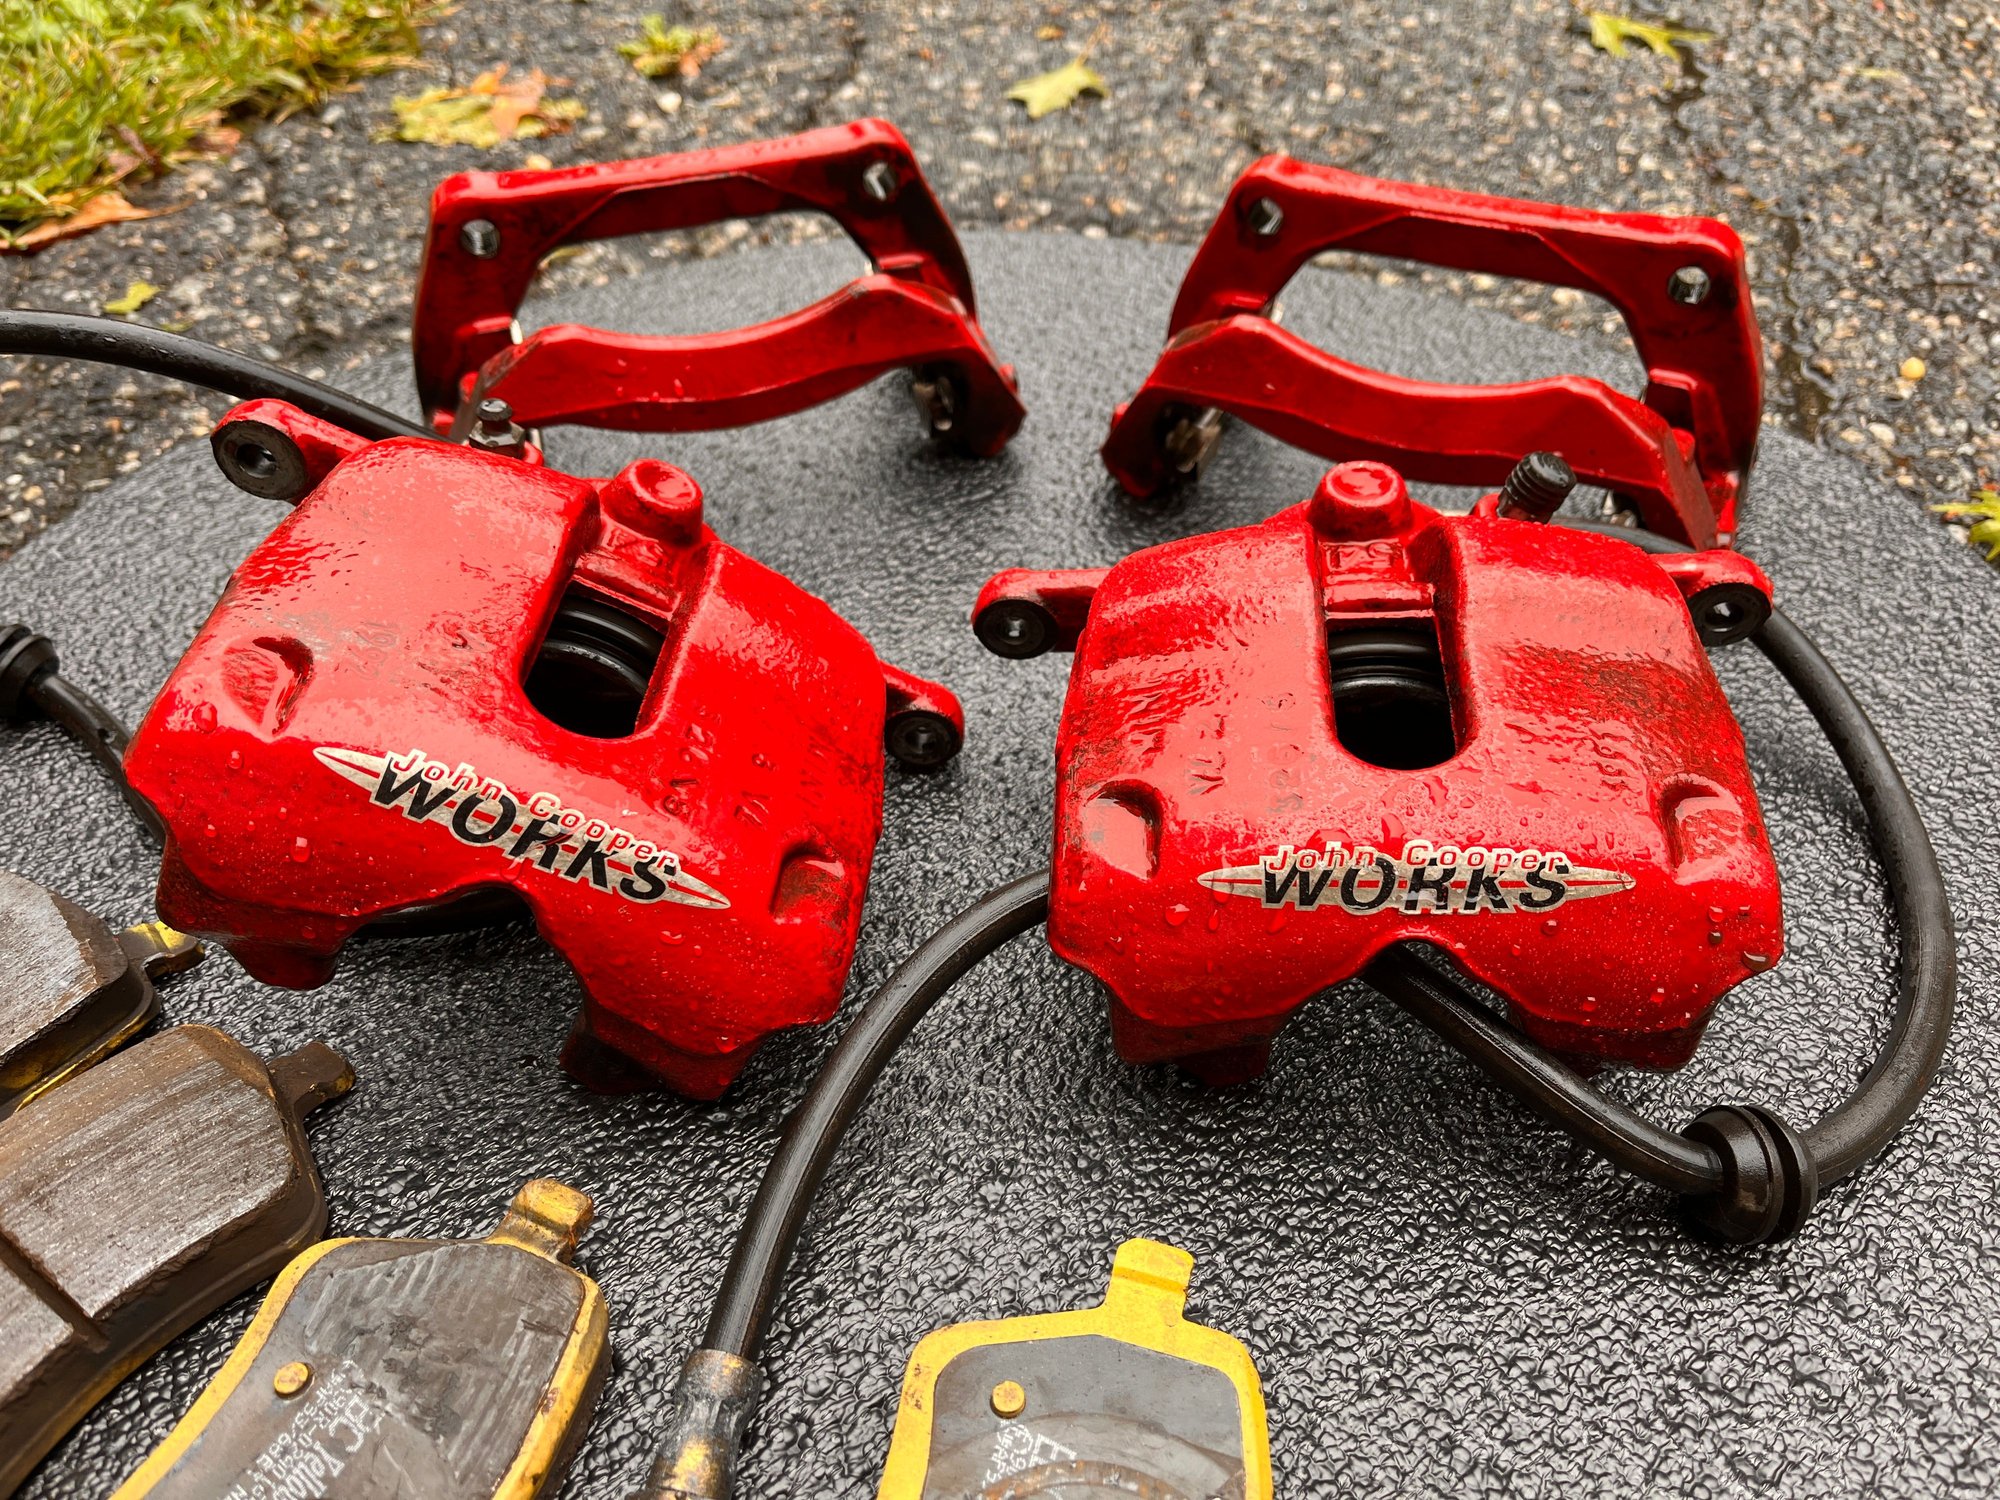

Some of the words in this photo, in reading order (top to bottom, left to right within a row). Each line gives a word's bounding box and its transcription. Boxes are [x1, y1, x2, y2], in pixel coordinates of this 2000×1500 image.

[373, 754, 678, 901] WORKS
[391, 753, 501, 802] John
[528, 792, 676, 869] Cooper
[1260, 855, 1571, 913] WORKS
[1267, 844, 1377, 872] John
[1406, 848, 1564, 873] Cooper
